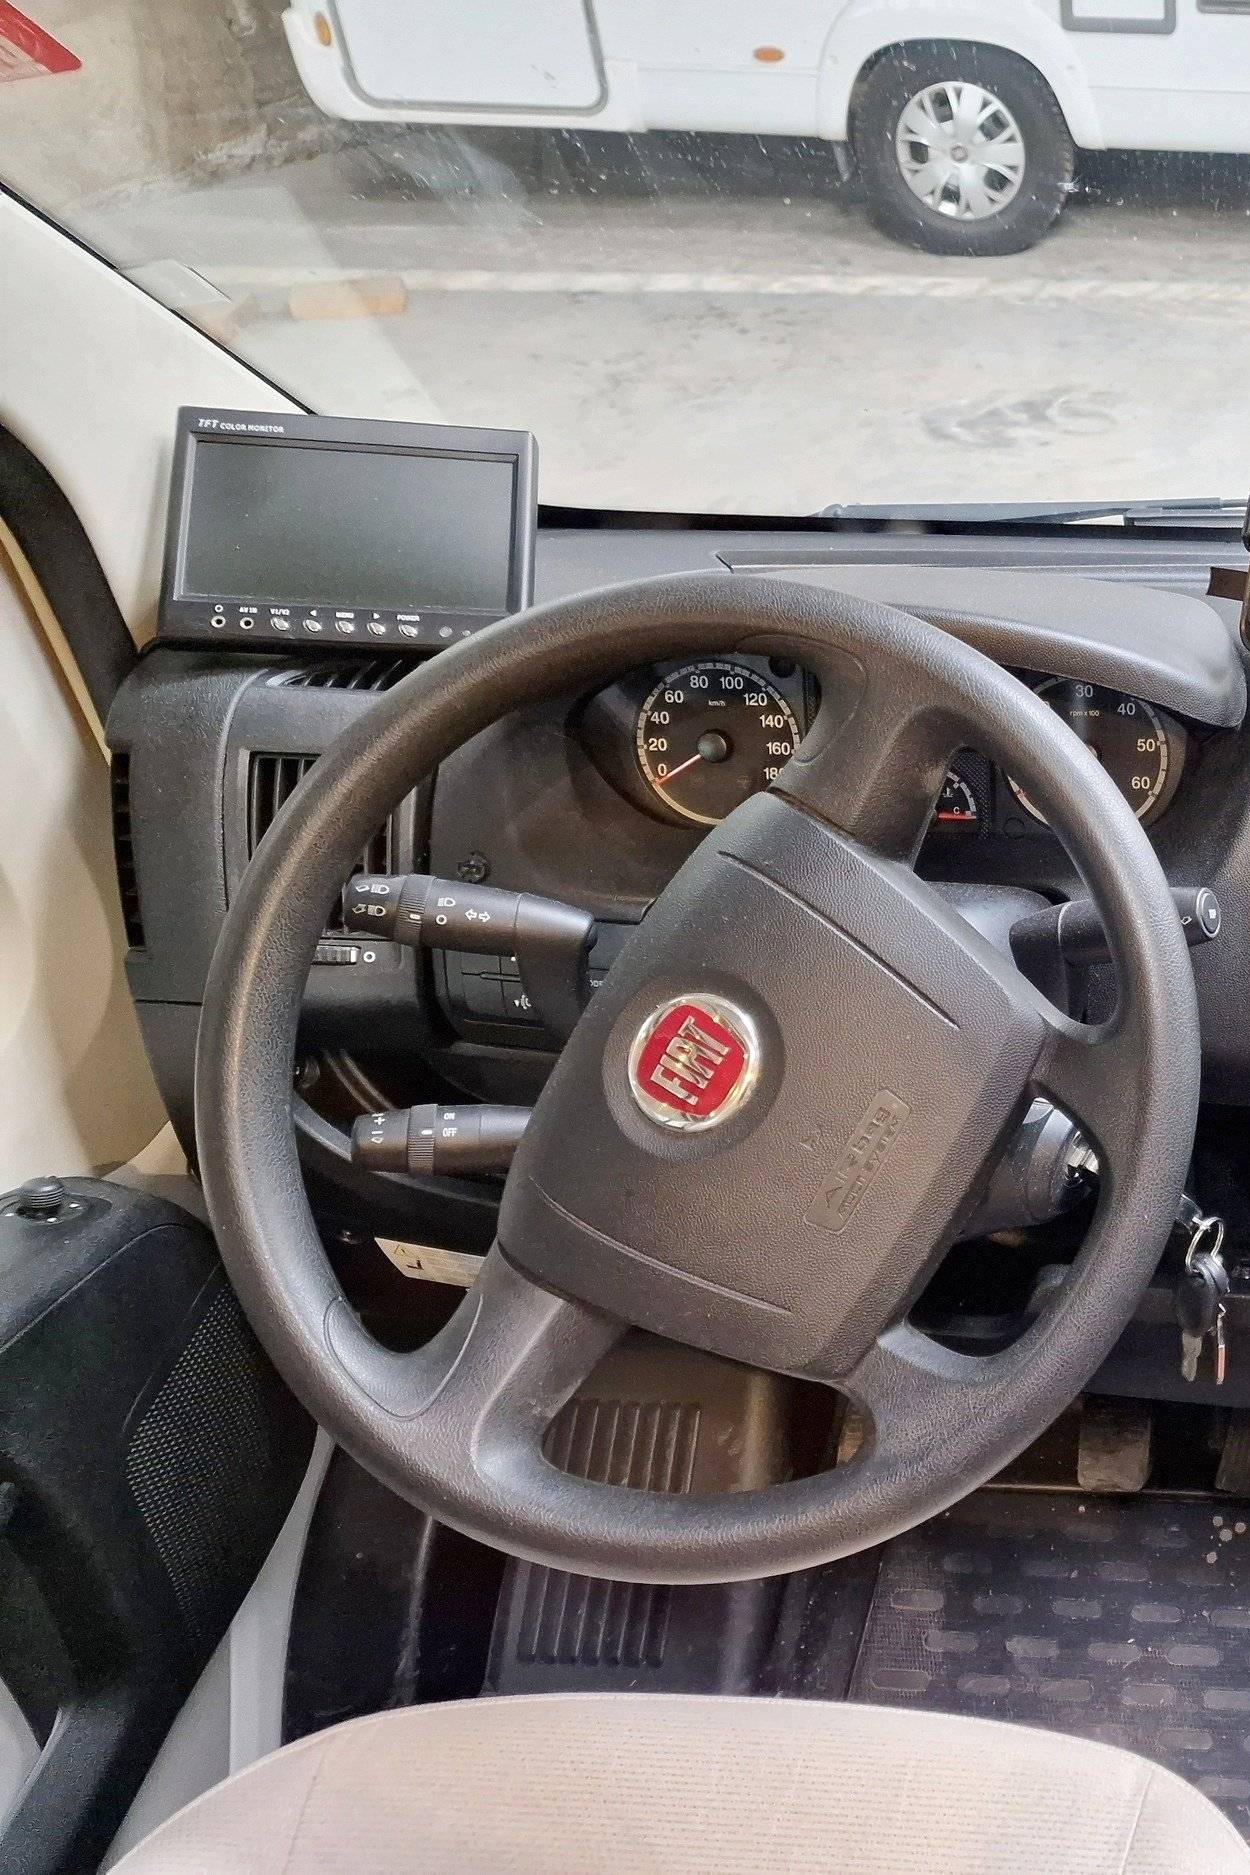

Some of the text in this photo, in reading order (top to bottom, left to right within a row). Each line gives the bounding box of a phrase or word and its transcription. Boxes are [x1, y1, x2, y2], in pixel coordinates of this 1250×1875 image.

[198, 418, 284, 433] TFT COLOR MONITOR
[690, 676, 709, 688] 80
[719, 676, 743, 690] 100
[664, 690, 684, 703] 60
[1075, 685, 1093, 698] 30
[743, 693, 768, 706] 120
[1117, 702, 1136, 715] 40
[651, 711, 670, 725] 40
[759, 714, 784, 728] 140
[648, 738, 667, 751] 20
[766, 742, 790, 755] 160
[1136, 739, 1155, 752] 50
[657, 764, 667, 776] 0
[1131, 776, 1150, 789] 60
[953, 806, 960, 815] C
[650, 1016, 731, 1106] FIAT
[443, 1112, 456, 1120] ON
[442, 1127, 458, 1137] OFF
